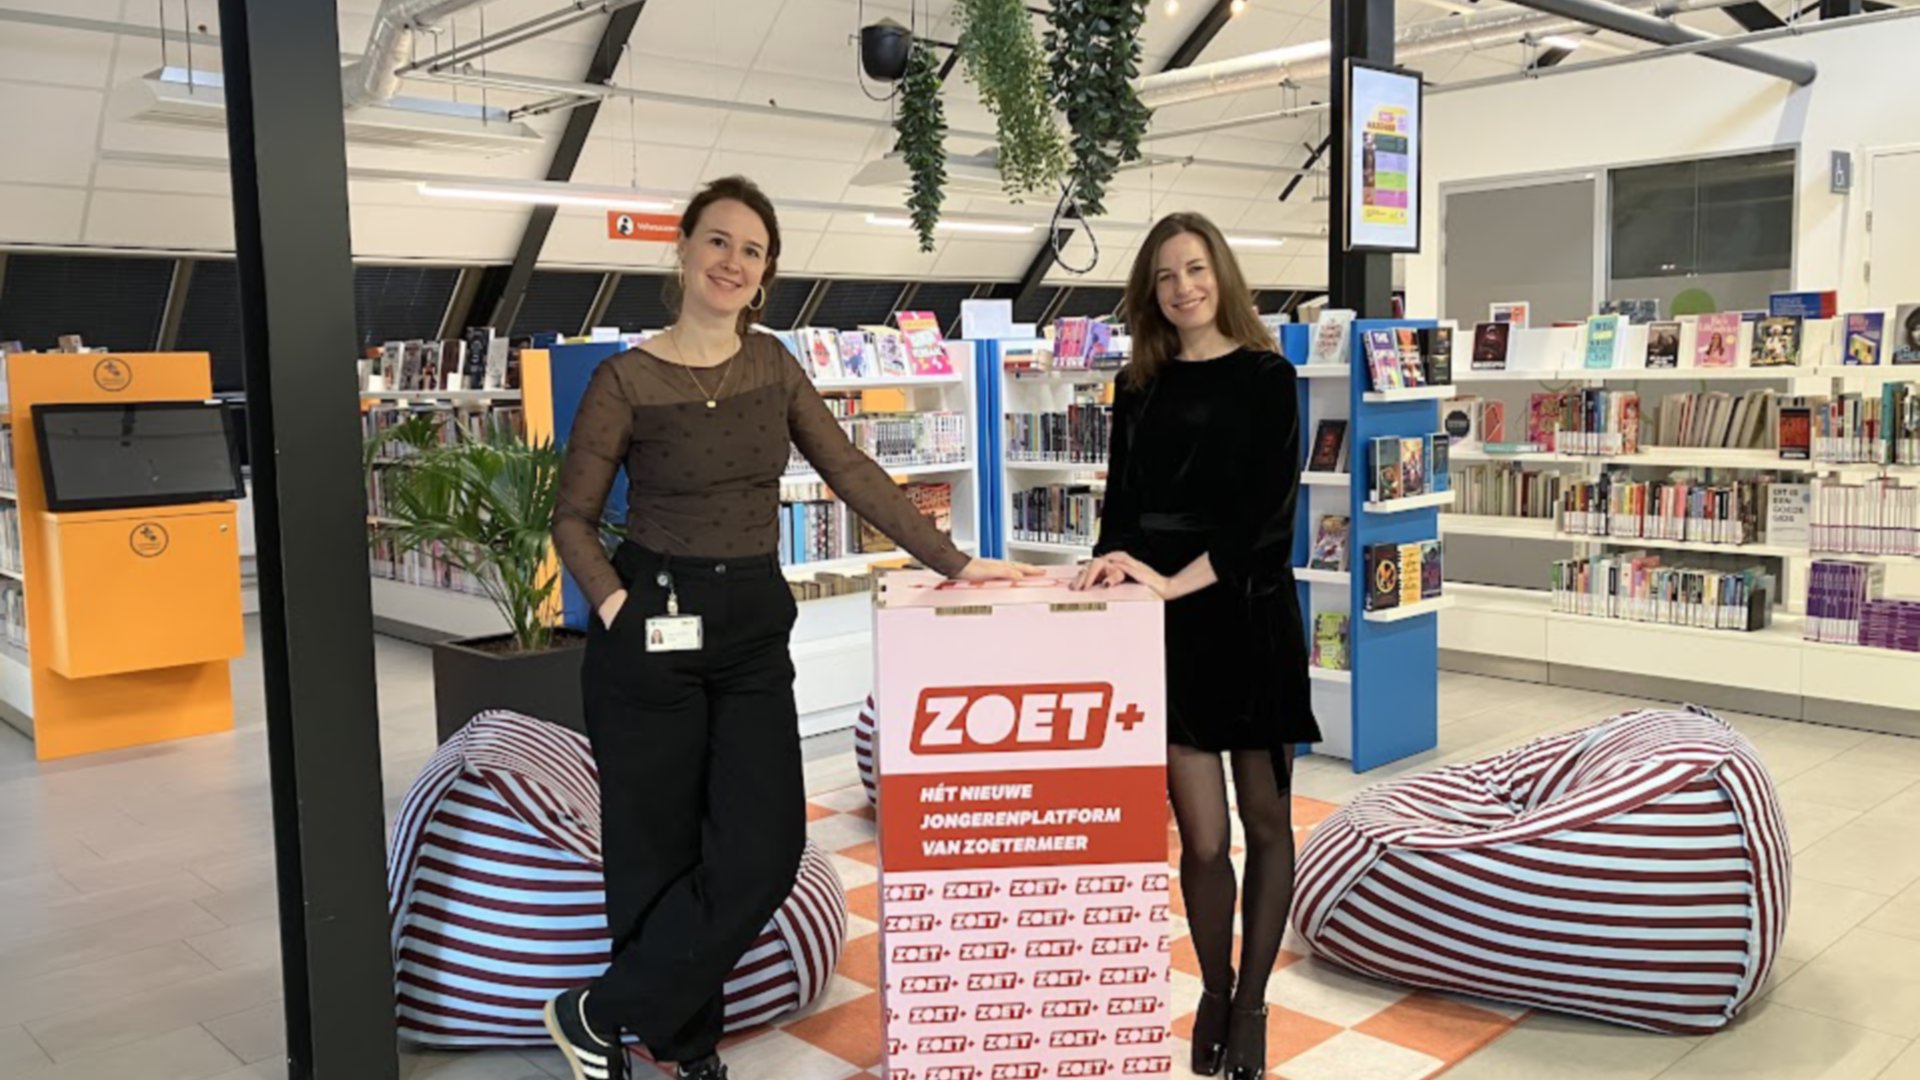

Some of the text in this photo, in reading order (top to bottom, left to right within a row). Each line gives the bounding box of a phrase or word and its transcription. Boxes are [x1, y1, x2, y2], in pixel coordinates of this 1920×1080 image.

[919, 691, 1145, 746] ZOET+
[920, 783, 1033, 802] HÉT NIEUWE
[920, 807, 1121, 830] JONGERENPLATFORM
[922, 835, 1089, 856] VAN ZOETERMEER
